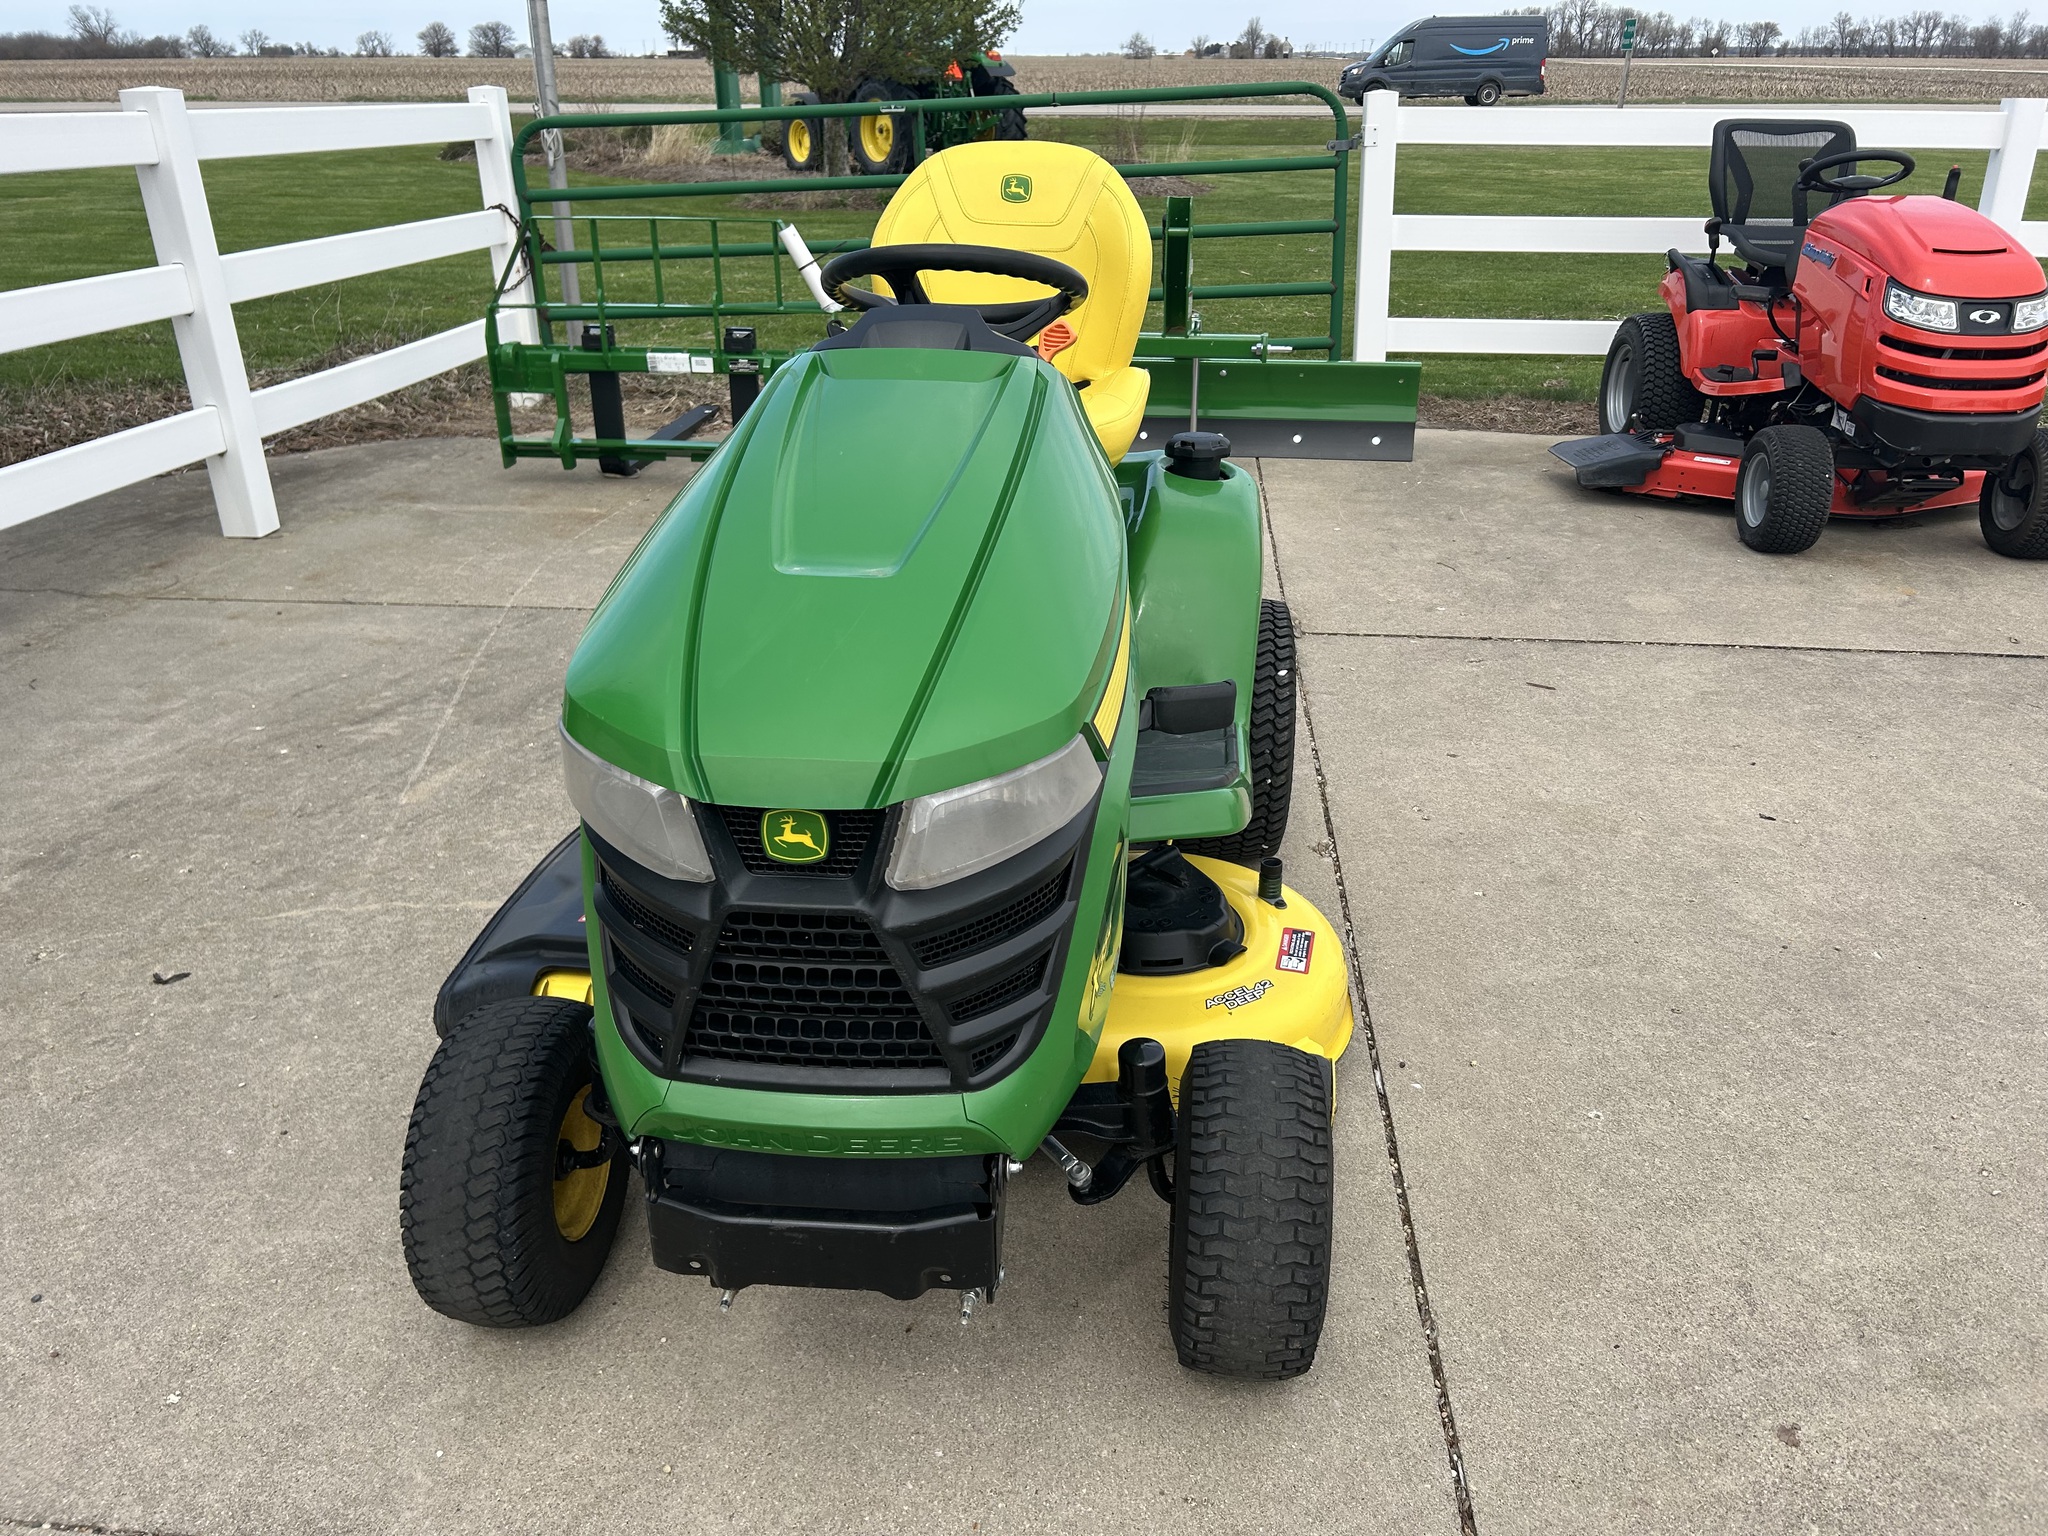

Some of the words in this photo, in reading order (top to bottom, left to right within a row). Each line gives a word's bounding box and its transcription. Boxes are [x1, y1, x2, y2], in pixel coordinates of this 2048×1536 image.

[1511, 35, 1534, 46] prime
[1205, 985, 1255, 1010] ACCEL
[1223, 988, 1266, 1010] DEEP
[673, 1118, 793, 1152] JOHN
[804, 1130, 965, 1155] DEERE
